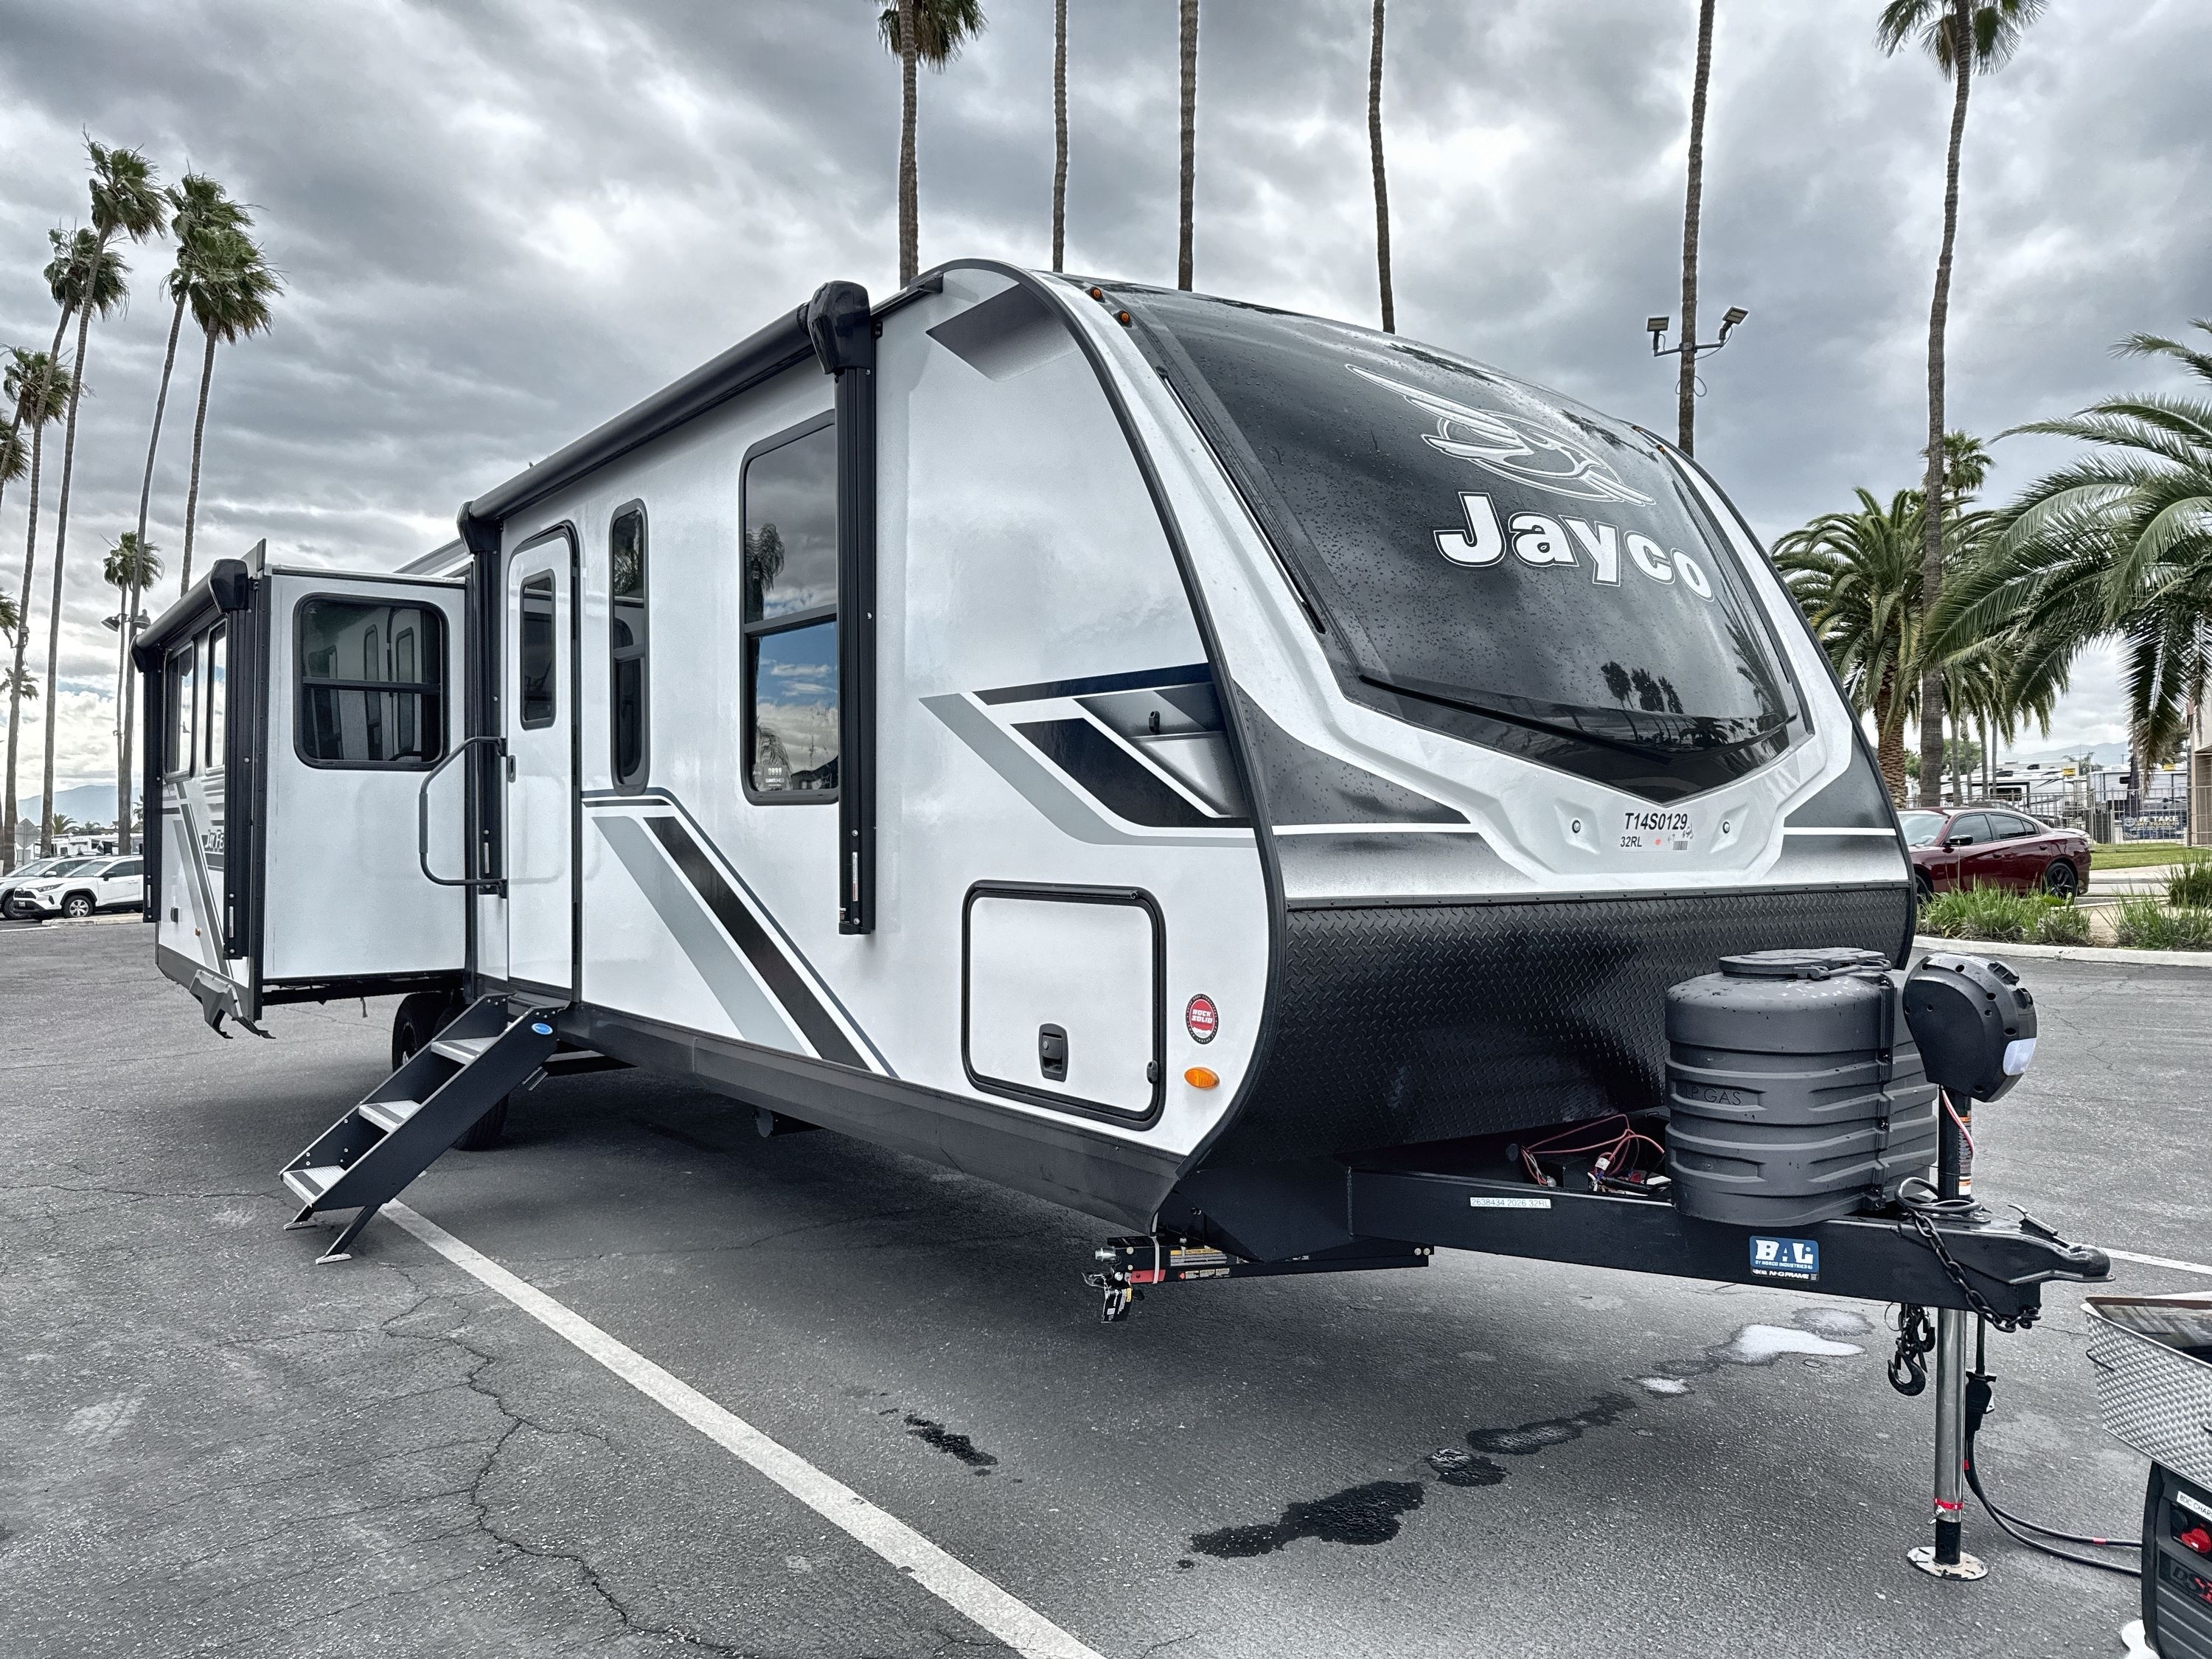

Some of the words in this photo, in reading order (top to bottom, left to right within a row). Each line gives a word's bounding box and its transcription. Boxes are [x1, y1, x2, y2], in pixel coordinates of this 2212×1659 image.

[1433, 491, 1714, 602] Jayco
[1625, 813, 1688, 830] T14S0129
[1621, 836, 1642, 847] 32RL
[1191, 1015, 1214, 1024] SOLID
[1192, 1009, 1211, 1018] ROCK
[1686, 1085, 1700, 1099] LP
[1704, 1088, 1741, 1105] GAS
[1472, 1198, 1505, 1206] 2638434
[1528, 1200, 1551, 1208] 32RL
[1755, 1239, 1814, 1265] BAL
